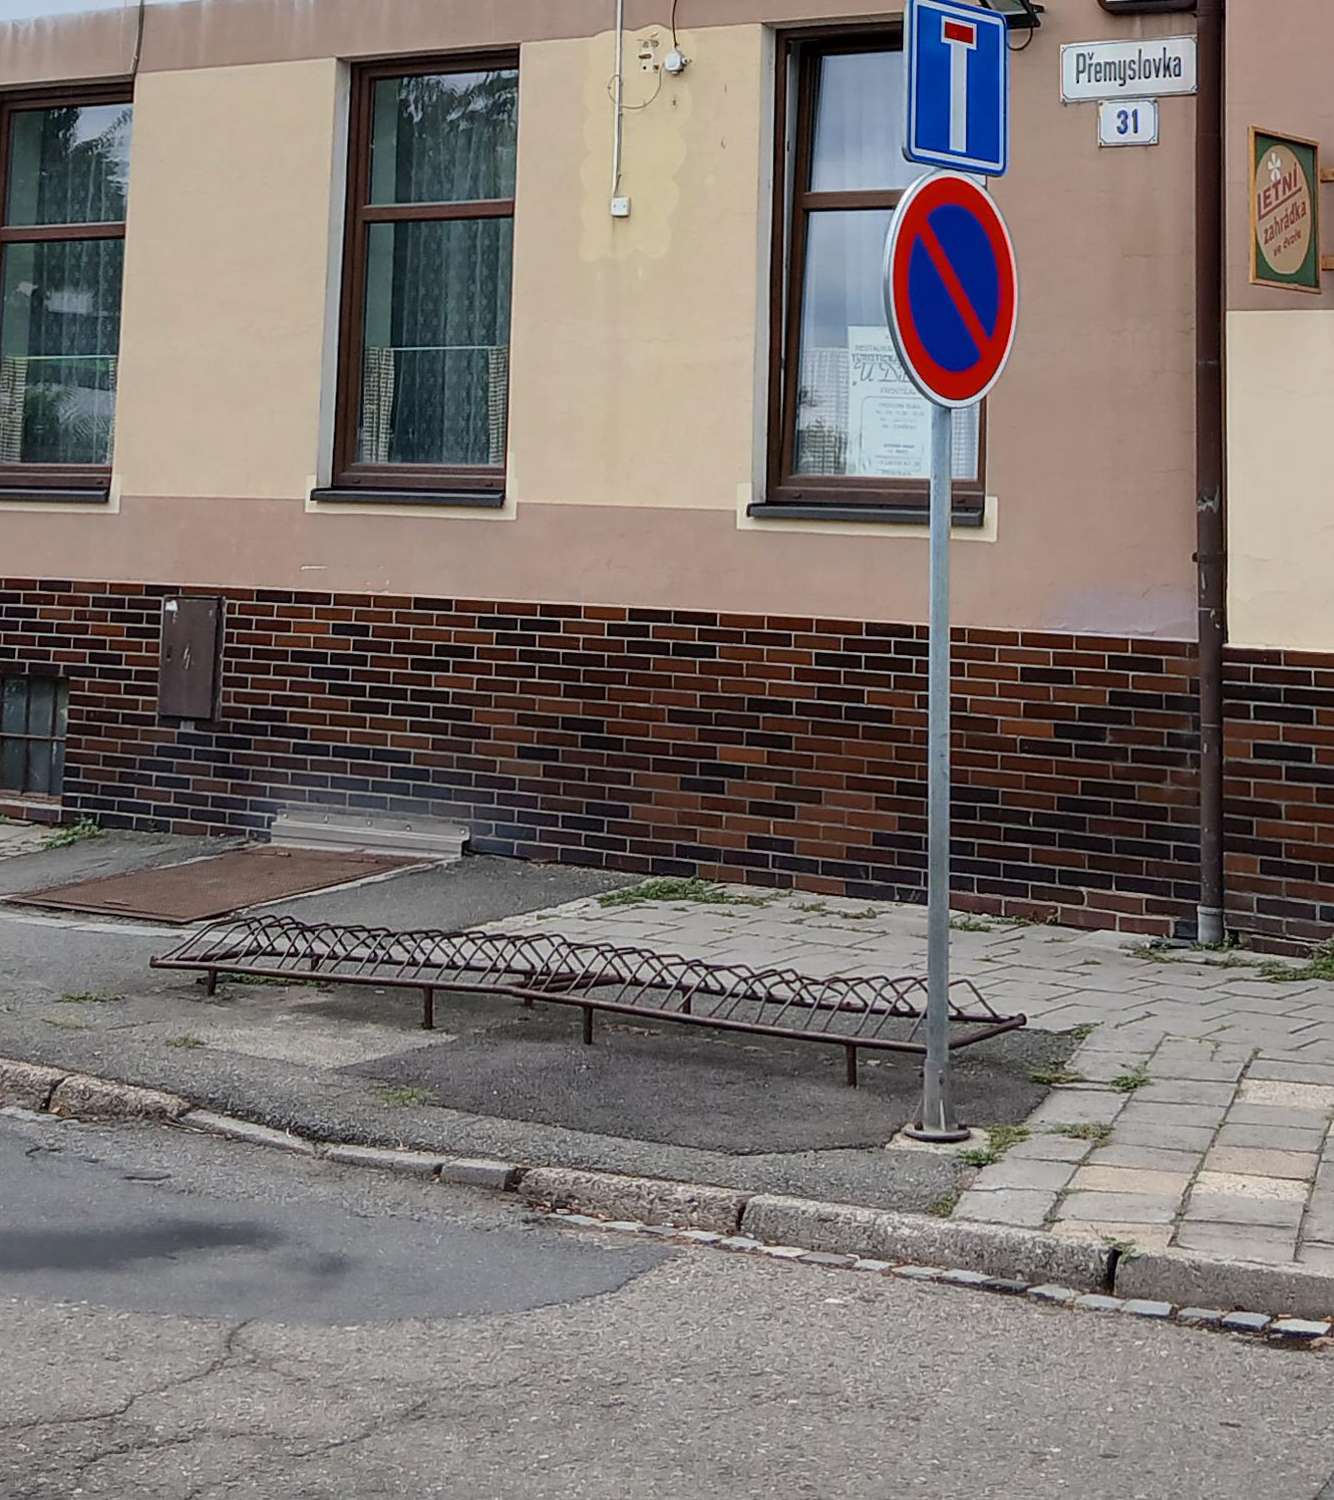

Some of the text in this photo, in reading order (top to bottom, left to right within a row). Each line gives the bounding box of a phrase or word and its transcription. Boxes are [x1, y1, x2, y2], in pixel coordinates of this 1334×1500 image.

[1076, 47, 1182, 87] Přemyslovka
[1116, 108, 1139, 135] 31
[1257, 162, 1302, 220] LETNÍ
[1263, 200, 1307, 245] zahrádka
